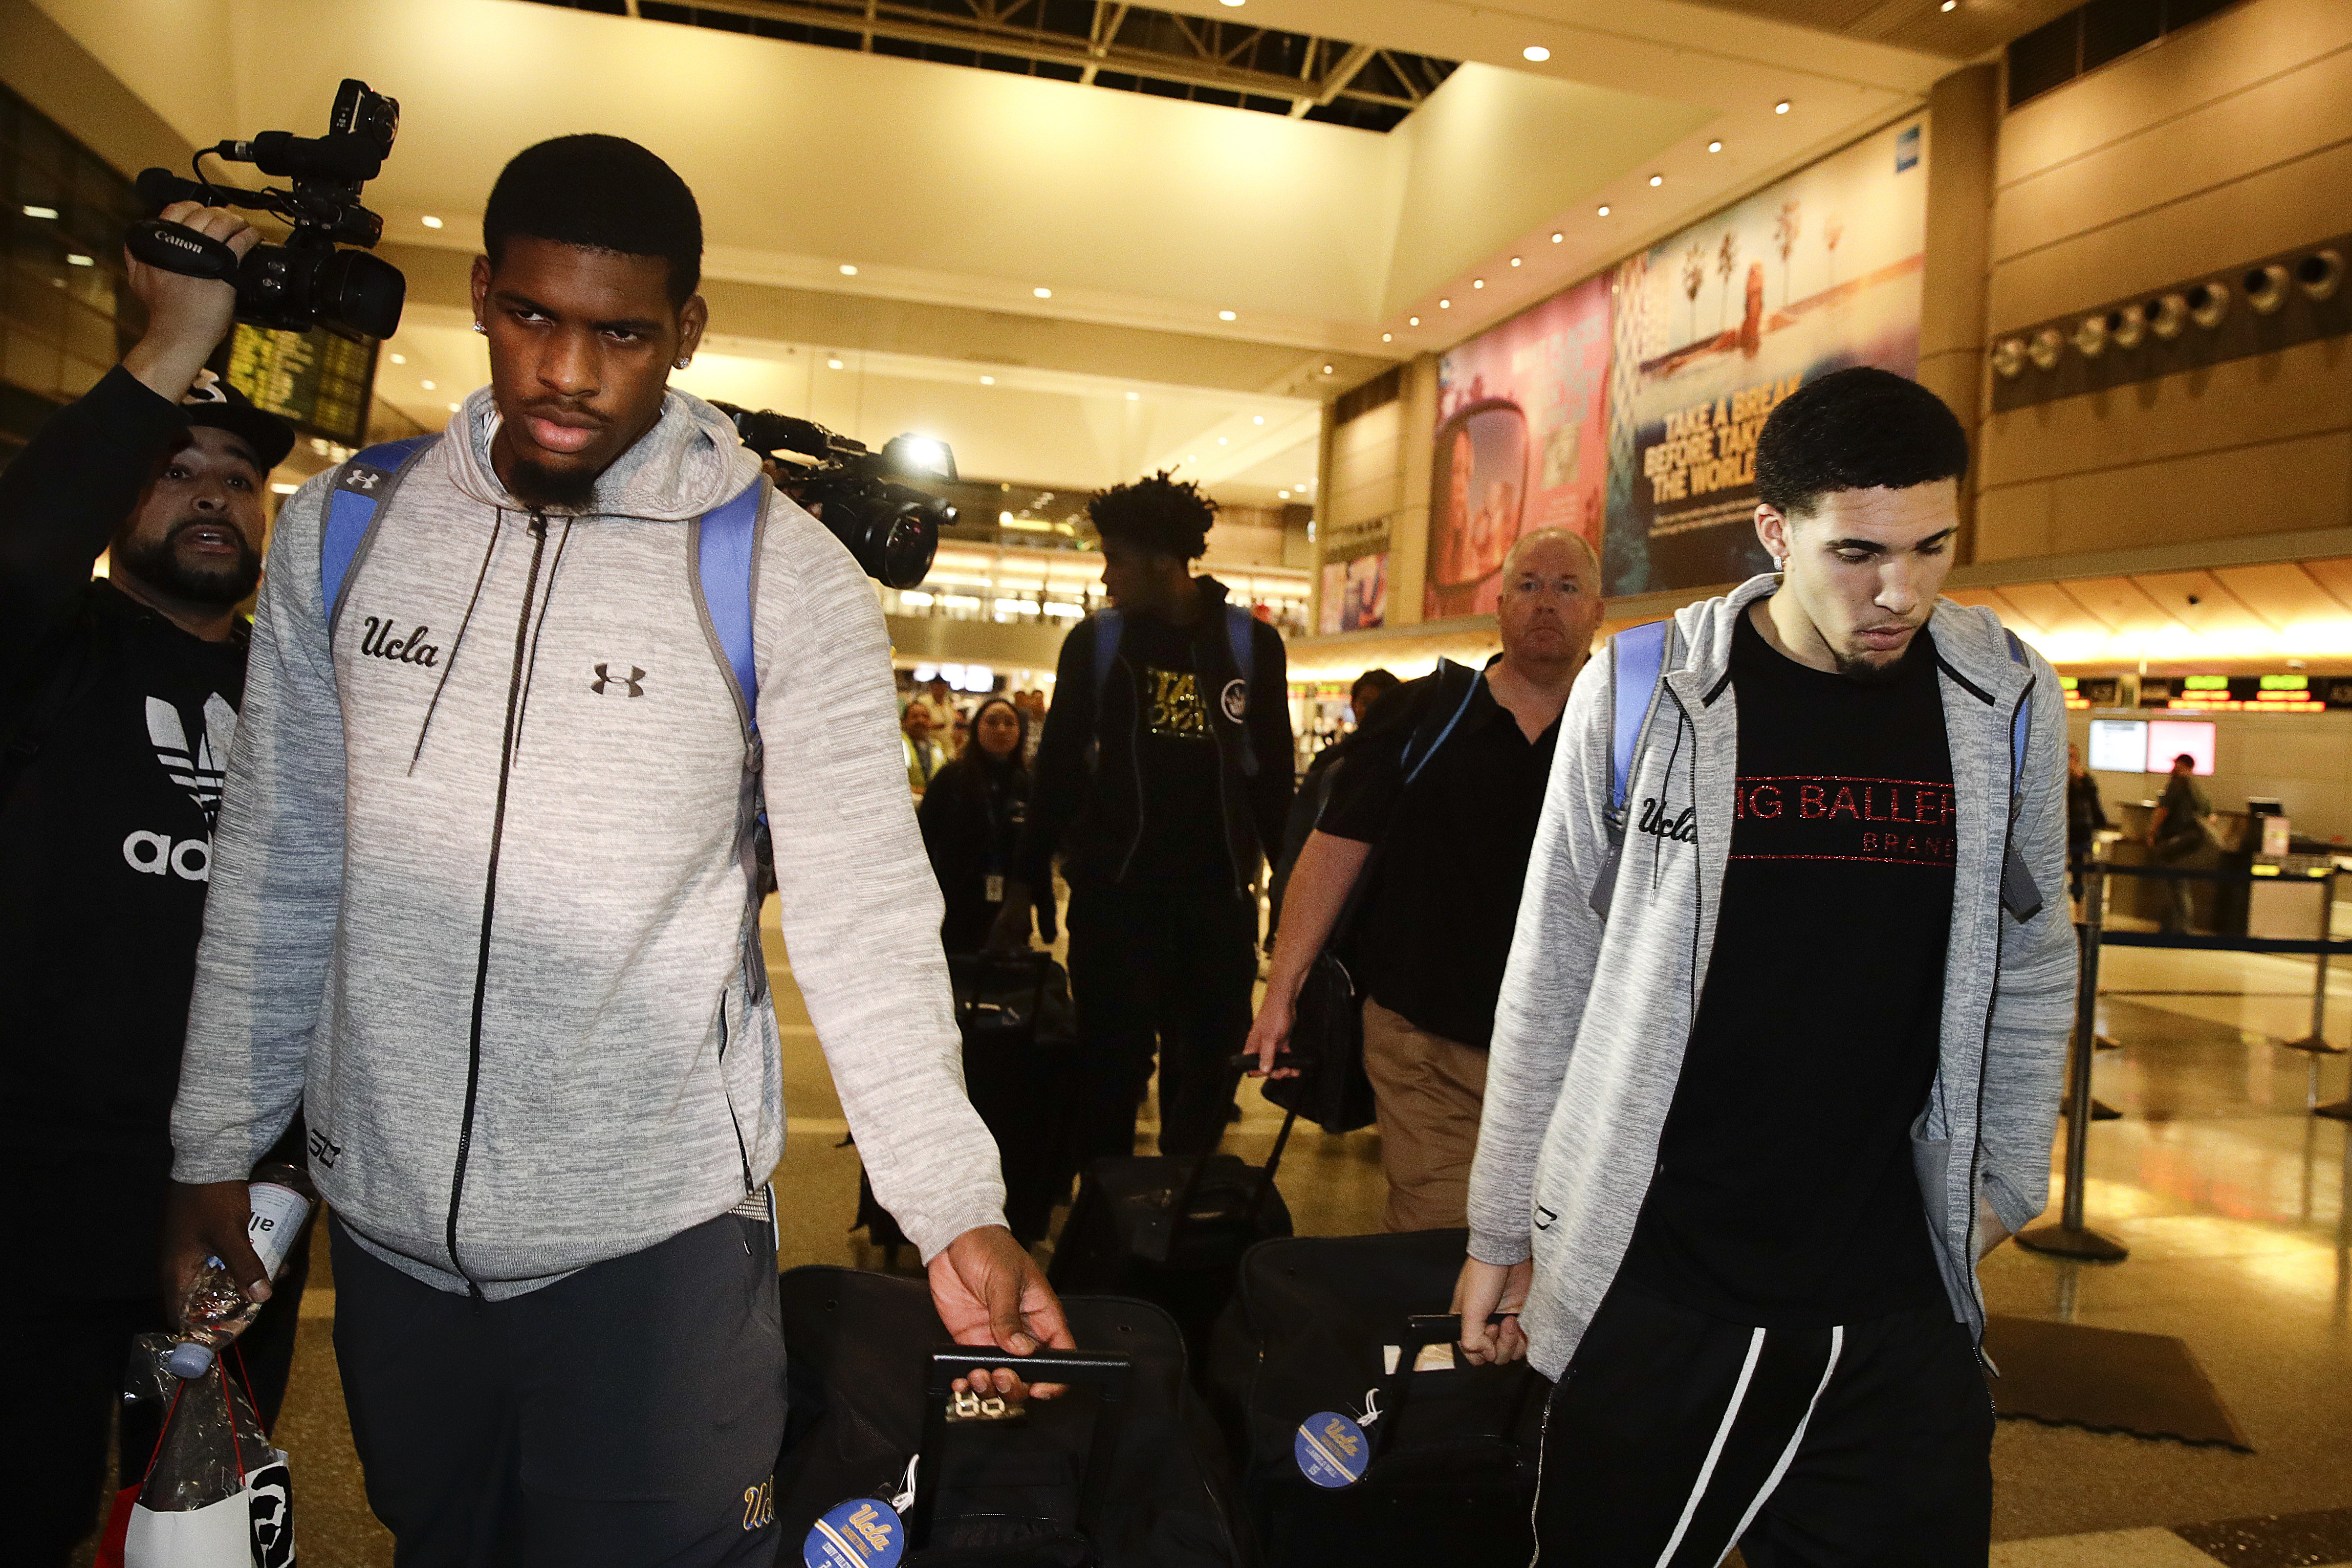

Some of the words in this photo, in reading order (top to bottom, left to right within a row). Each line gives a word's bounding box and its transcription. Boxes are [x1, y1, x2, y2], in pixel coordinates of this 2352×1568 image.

[154, 230, 203, 254] Canon
[1664, 401, 1712, 442] TAKE
[1713, 397, 1730, 428] A
[1643, 430, 1716, 478] BEFORE
[1651, 467, 1689, 503] THE
[361, 616, 439, 667] Ucla
[249, 1211, 275, 1232] al
[1325, 1417, 1358, 1457] Ucla
[849, 1503, 893, 1551] Ucla
